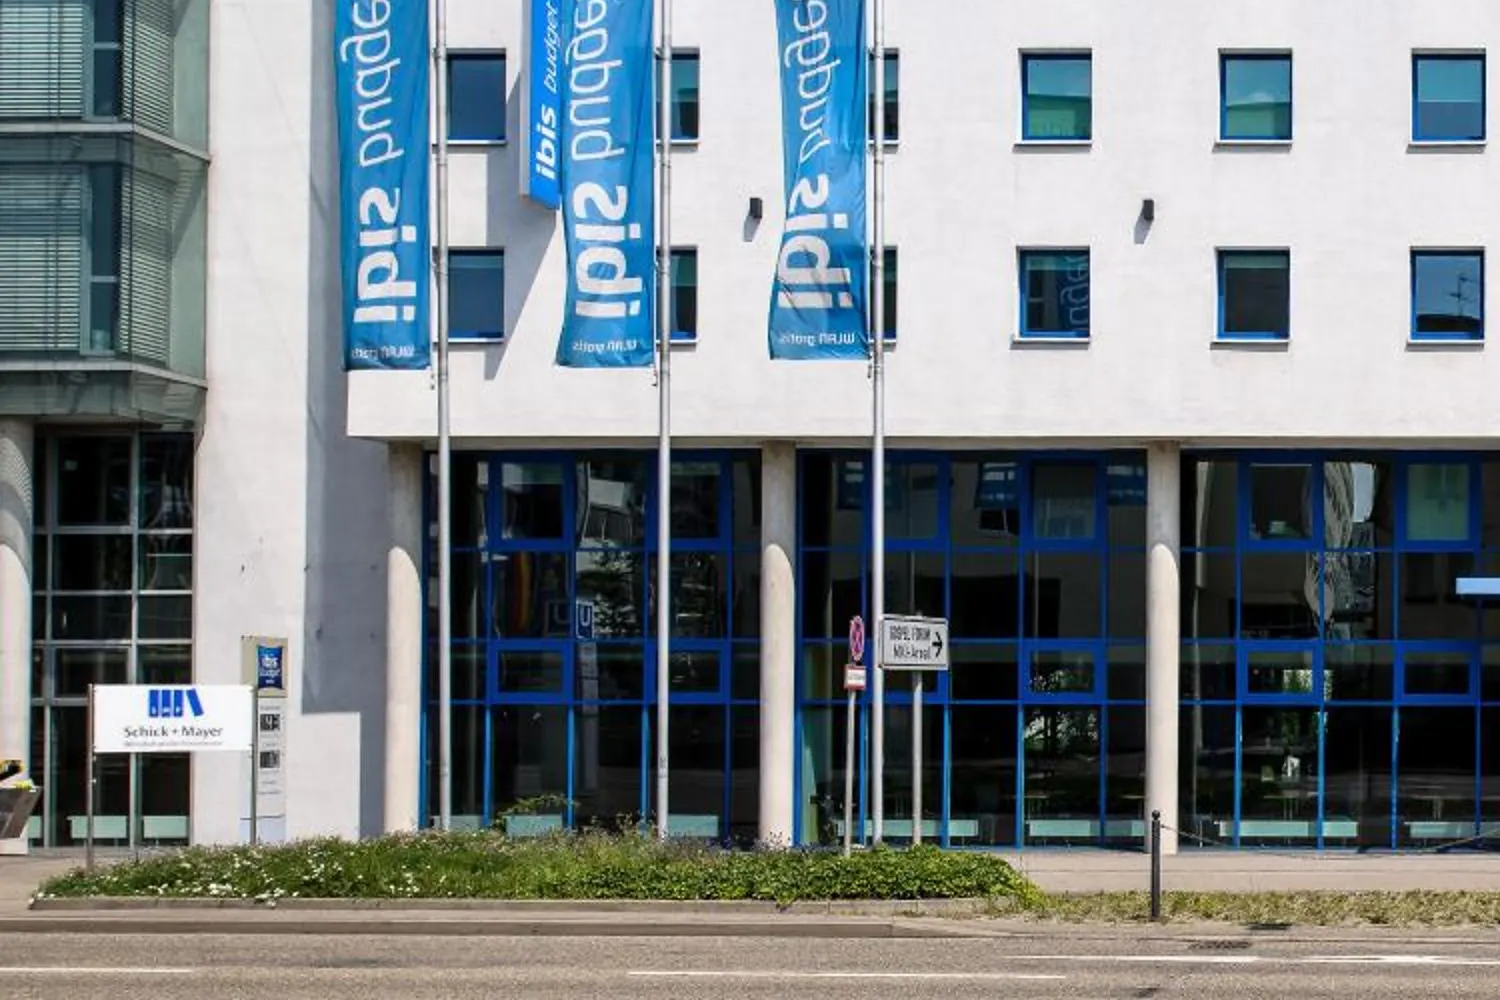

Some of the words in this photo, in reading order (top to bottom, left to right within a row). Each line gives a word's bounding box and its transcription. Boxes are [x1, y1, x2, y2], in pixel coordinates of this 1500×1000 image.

[543, 0, 561, 95] budget
[536, 103, 557, 182] ibis
[123, 725, 169, 738] Schick
[181, 725, 224, 739] Mayer
